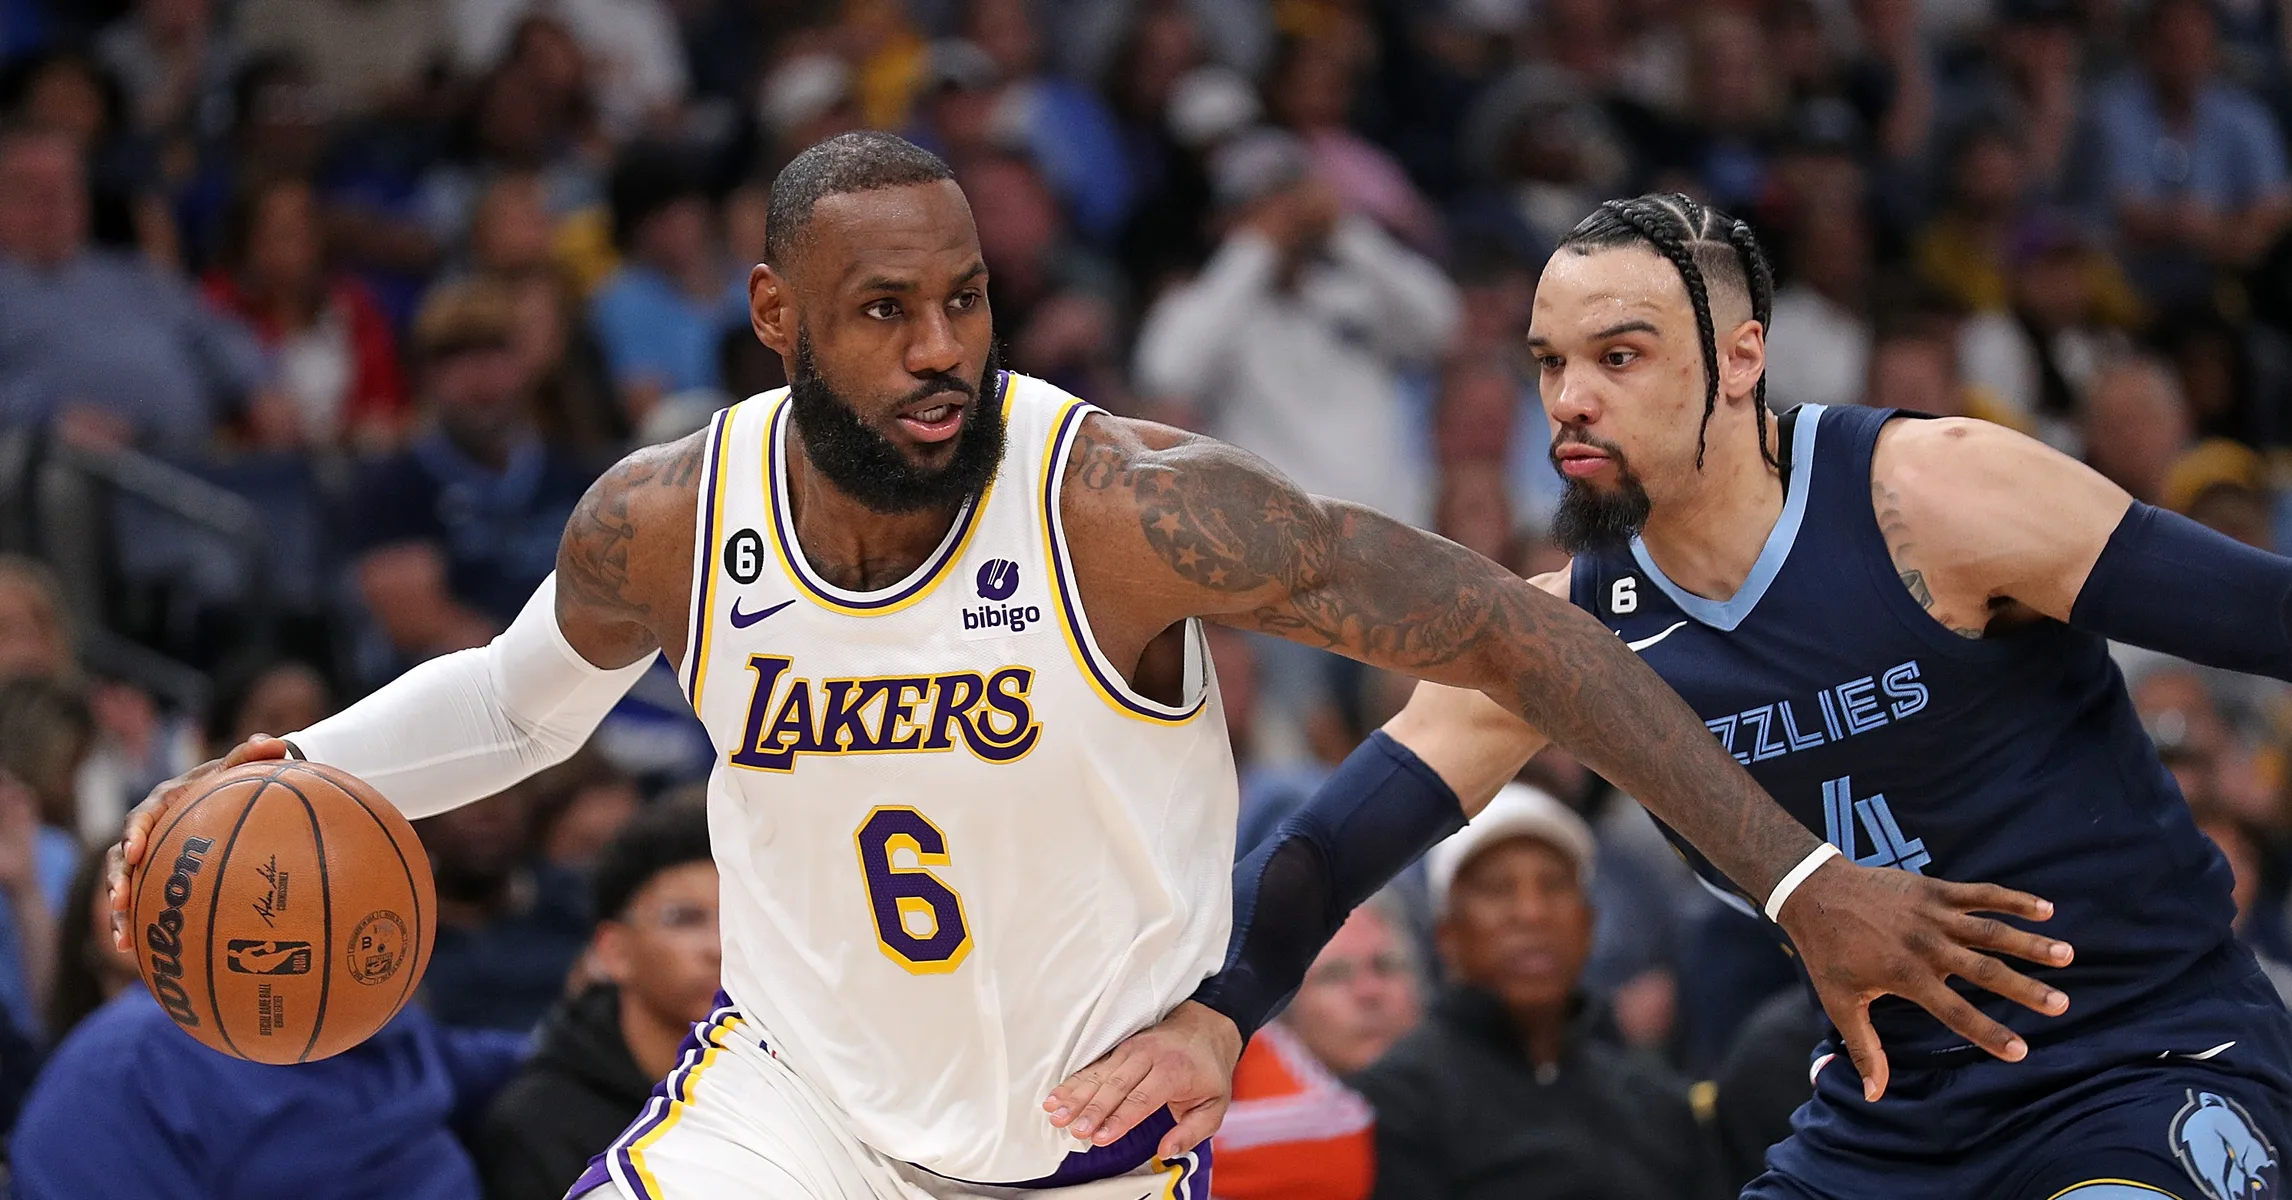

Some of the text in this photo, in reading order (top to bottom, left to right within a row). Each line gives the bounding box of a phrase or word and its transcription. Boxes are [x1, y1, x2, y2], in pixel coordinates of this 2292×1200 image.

[736, 537, 756, 577] 6
[1611, 576, 1638, 614] 6
[962, 604, 1040, 632] bibigo
[729, 653, 1043, 774] LAKERS
[1822, 775, 1932, 875] 4
[853, 805, 975, 976] 6
[147, 835, 216, 1028] Wilson
[292, 953, 307, 972] NBA
[258, 983, 271, 998] BALL
